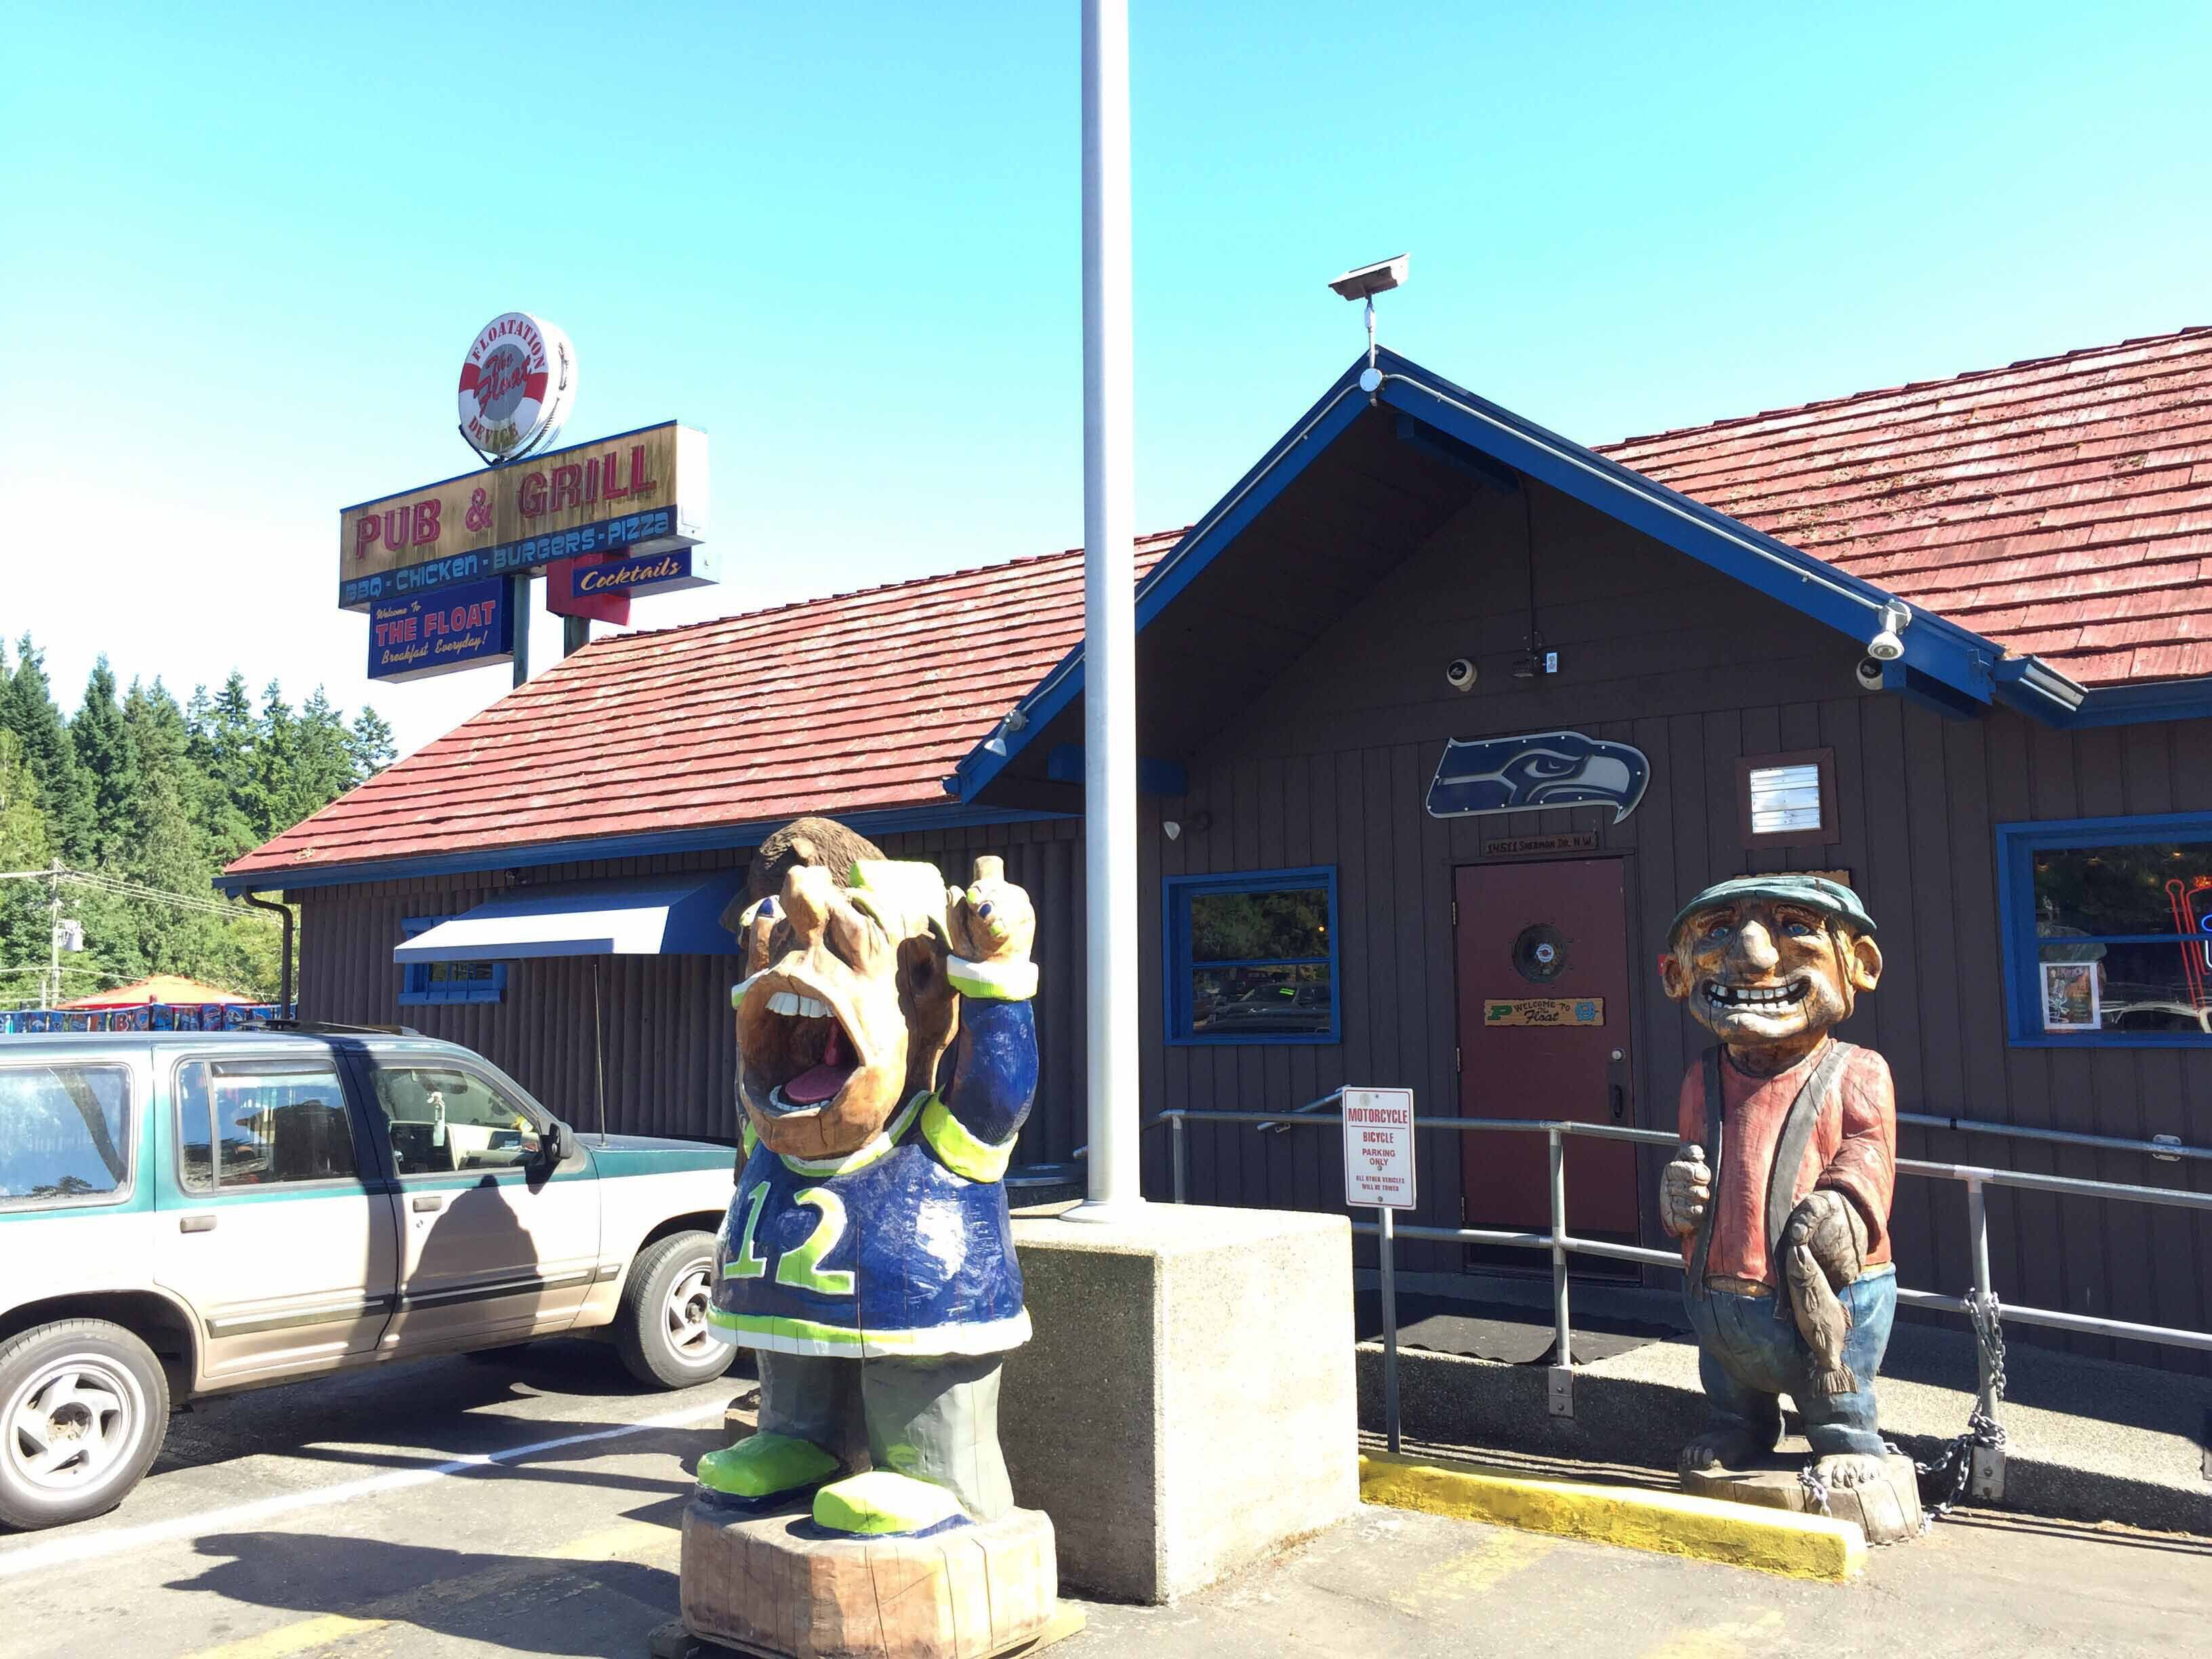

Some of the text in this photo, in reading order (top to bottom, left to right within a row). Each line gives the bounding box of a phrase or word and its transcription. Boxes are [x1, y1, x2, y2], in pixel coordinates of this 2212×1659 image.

[472, 319, 545, 369] FLOATATION
[473, 355, 531, 418] Float
[468, 415, 518, 444] DEVICE
[356, 445, 657, 560] PUB & GRILL
[581, 557, 682, 591] Cocktails
[346, 577, 383, 600] BBQ
[375, 600, 495, 647] THE FLOAT
[376, 607, 407, 620] Welcome
[381, 630, 488, 664] Breakfast Everyday!
[1513, 1001, 1571, 1012] WELCOME TO
[1525, 1009, 1559, 1024] Float
[1348, 1108, 1408, 1124] MOTORCYCLE
[1363, 1131, 1393, 1143] BICYCLE
[1362, 1149, 1395, 1158] PARKING
[1370, 1158, 1389, 1166] ONLY
[724, 1181, 855, 1296] 12
